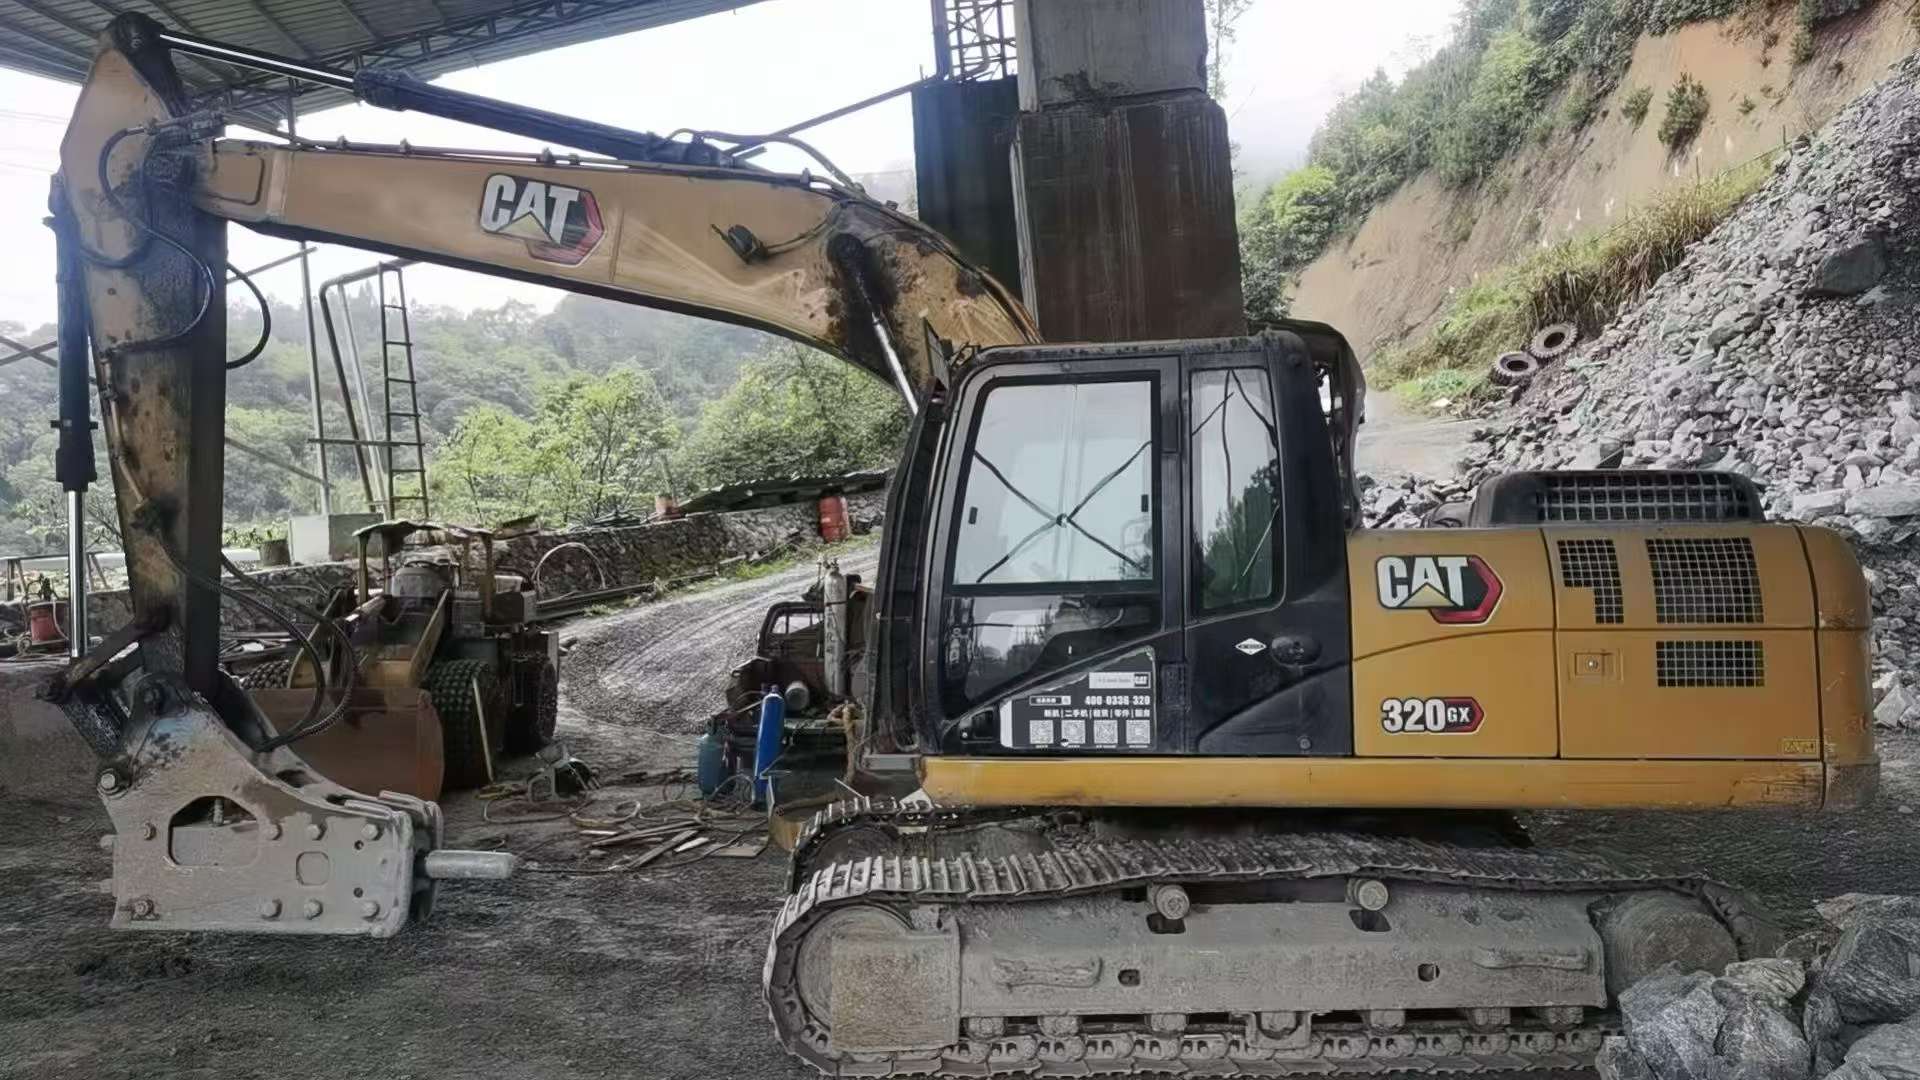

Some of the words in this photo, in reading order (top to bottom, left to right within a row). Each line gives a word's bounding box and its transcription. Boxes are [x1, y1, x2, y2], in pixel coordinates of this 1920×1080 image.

[480, 174, 580, 244] CAT
[1377, 556, 1468, 607] CAT
[1133, 695, 1150, 705] 320
